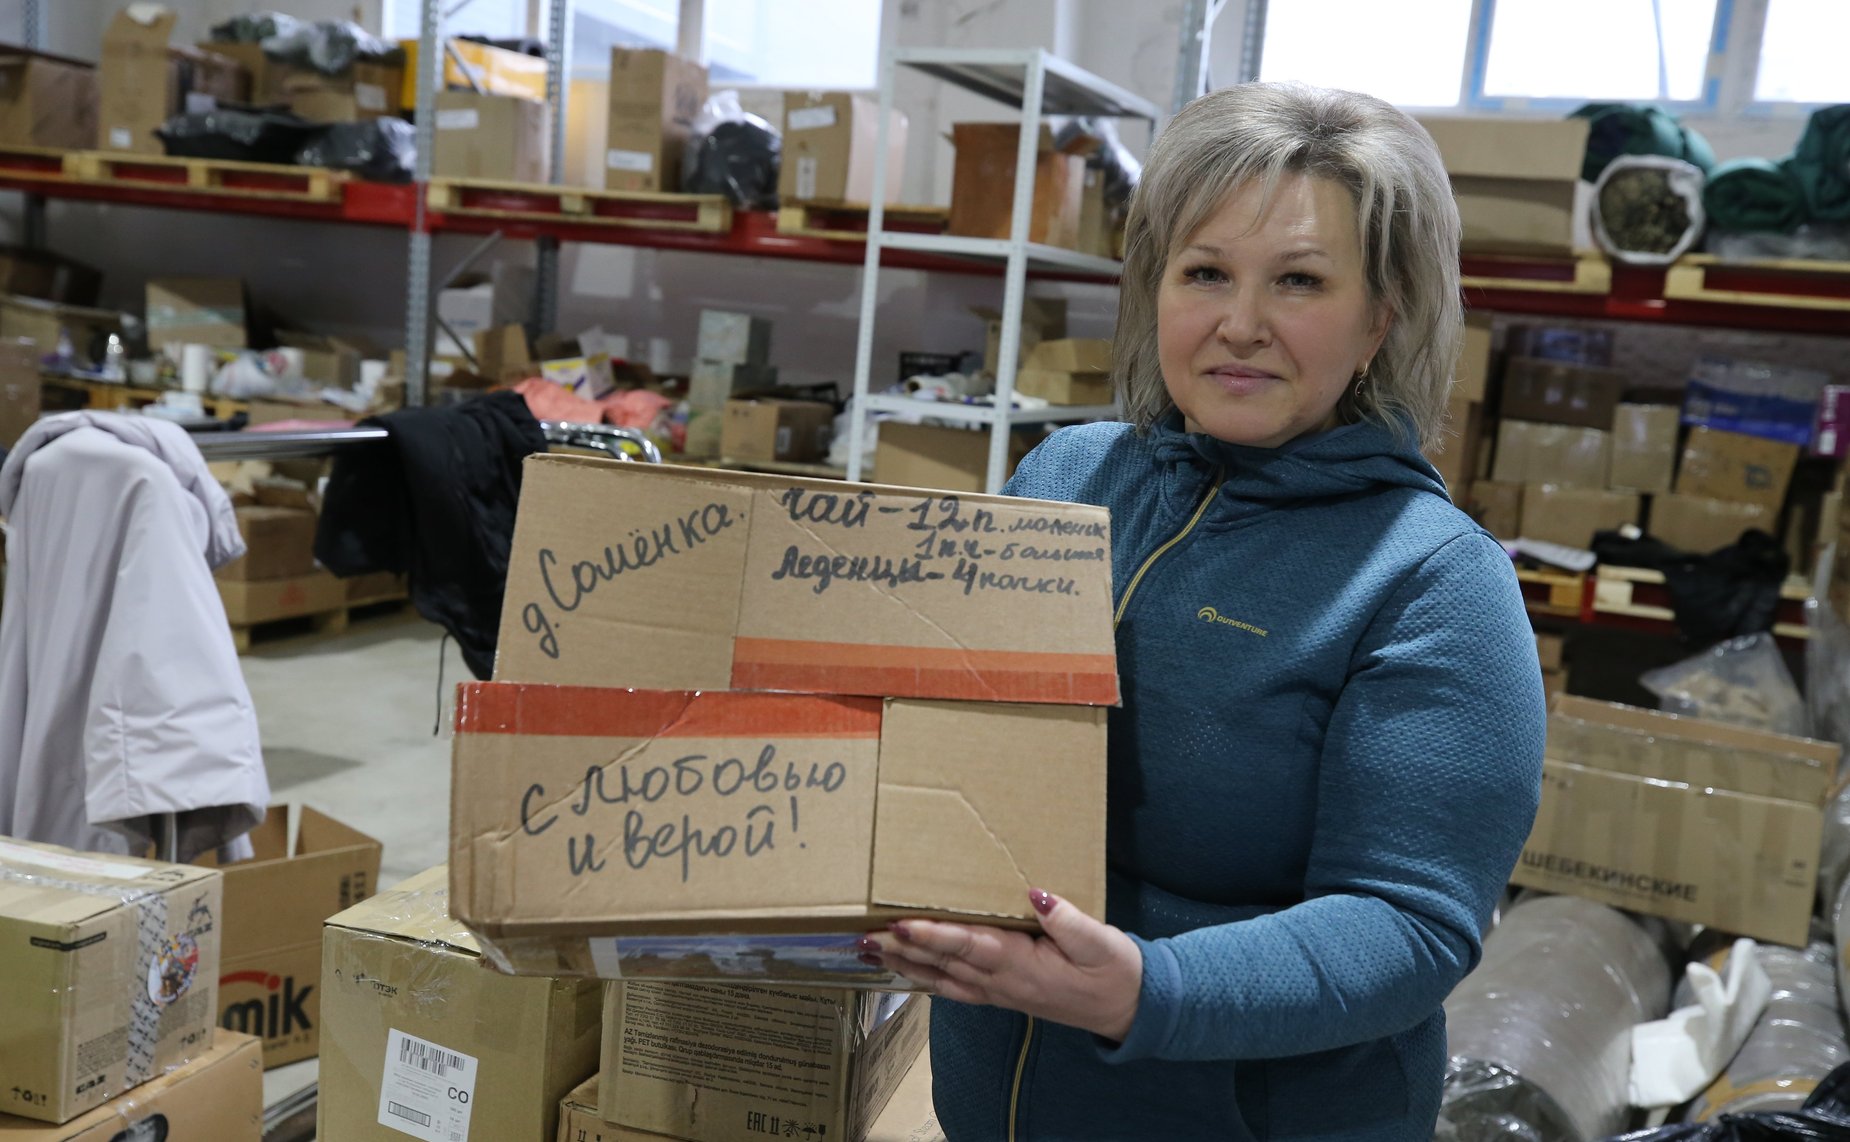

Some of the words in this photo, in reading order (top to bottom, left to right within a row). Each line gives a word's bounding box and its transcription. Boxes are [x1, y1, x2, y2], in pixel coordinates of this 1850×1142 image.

[1216, 615, 1269, 638] OUTVENTURE
[568, 834, 606, 876] и
[623, 795, 806, 883] верой!
[1522, 851, 1699, 902] ШЕБЕКИНСКИЕ
[638, 1037, 650, 1046] PET
